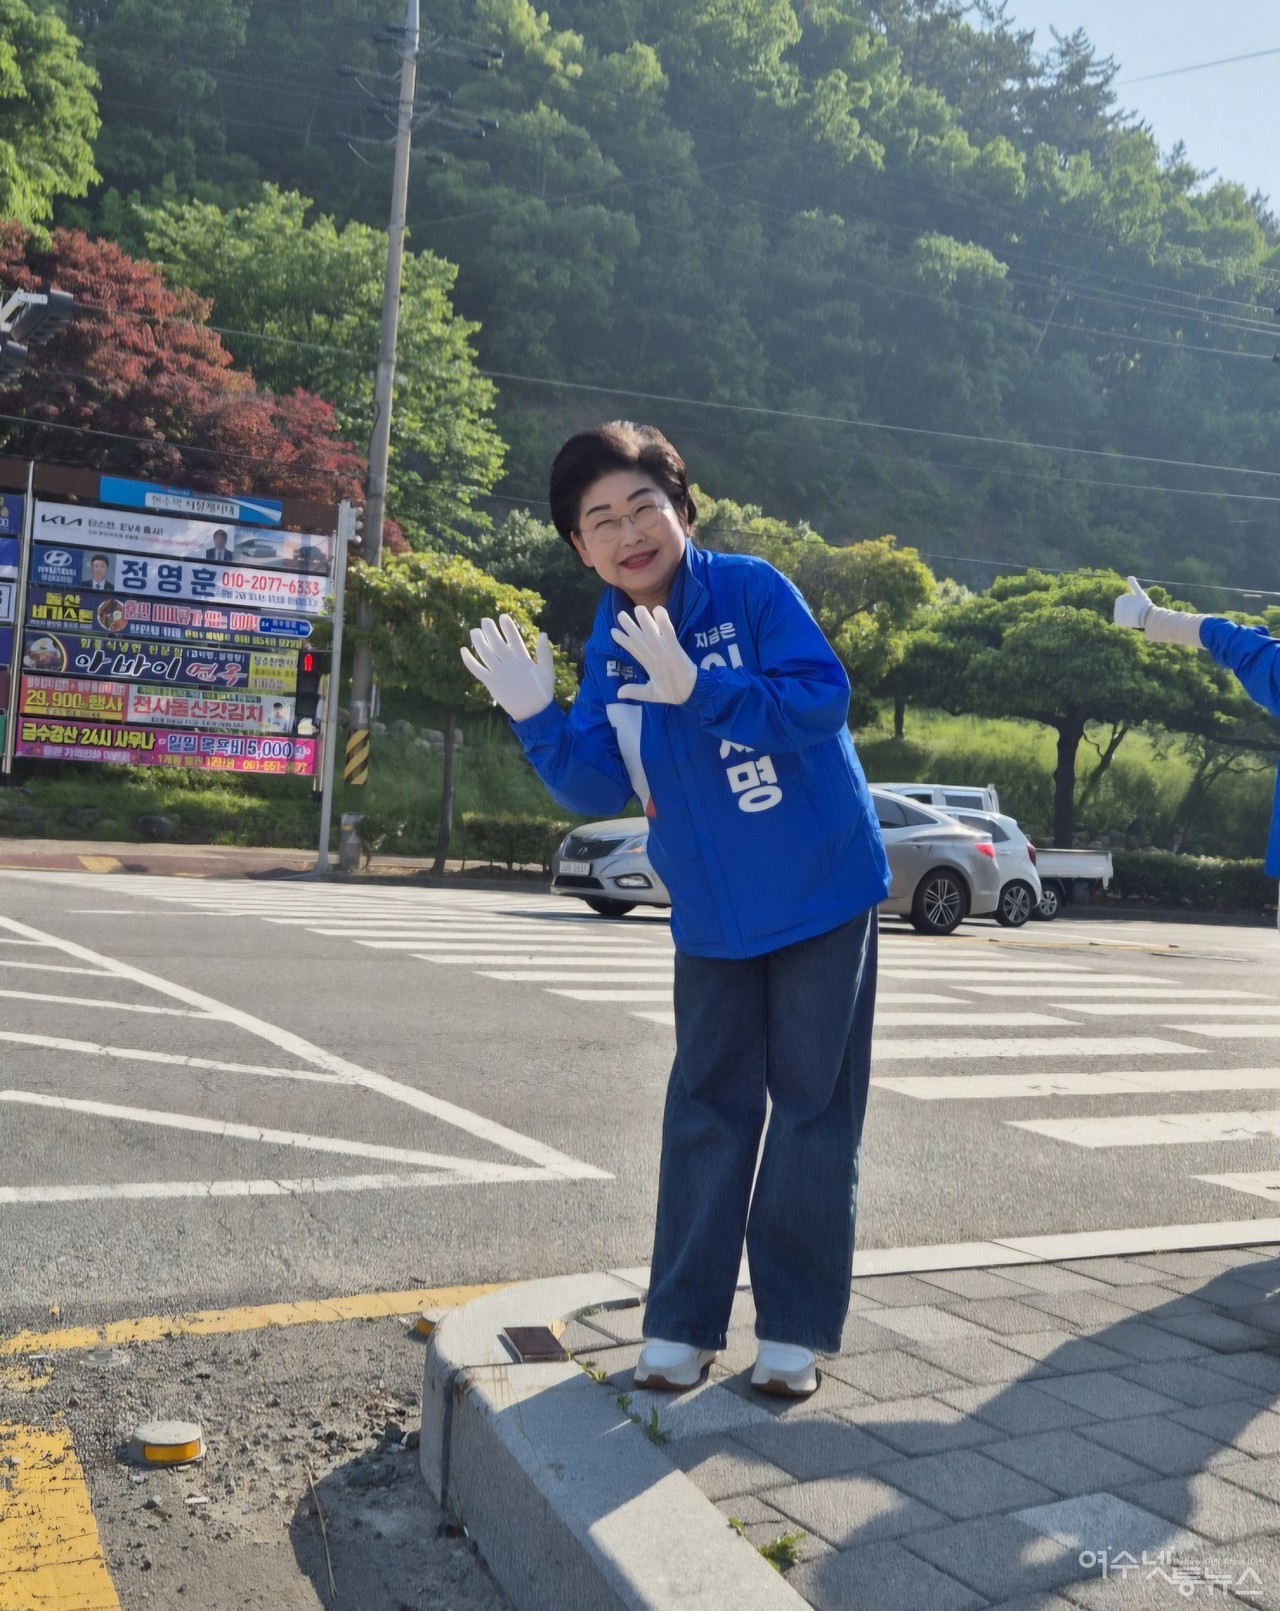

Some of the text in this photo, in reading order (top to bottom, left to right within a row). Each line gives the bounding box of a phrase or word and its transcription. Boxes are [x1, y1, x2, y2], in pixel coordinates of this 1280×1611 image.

[120, 522, 141, 533] EV4
[122, 559, 217, 597] 정영훈
[222, 571, 320, 596] 010-2077-6333
[694, 622, 736, 648] 지금은
[75, 649, 182, 681] 아바이
[133, 694, 264, 723] 천사돌산갓김치
[22, 722, 79, 745] 금수강산
[80, 728, 112, 747] 24시
